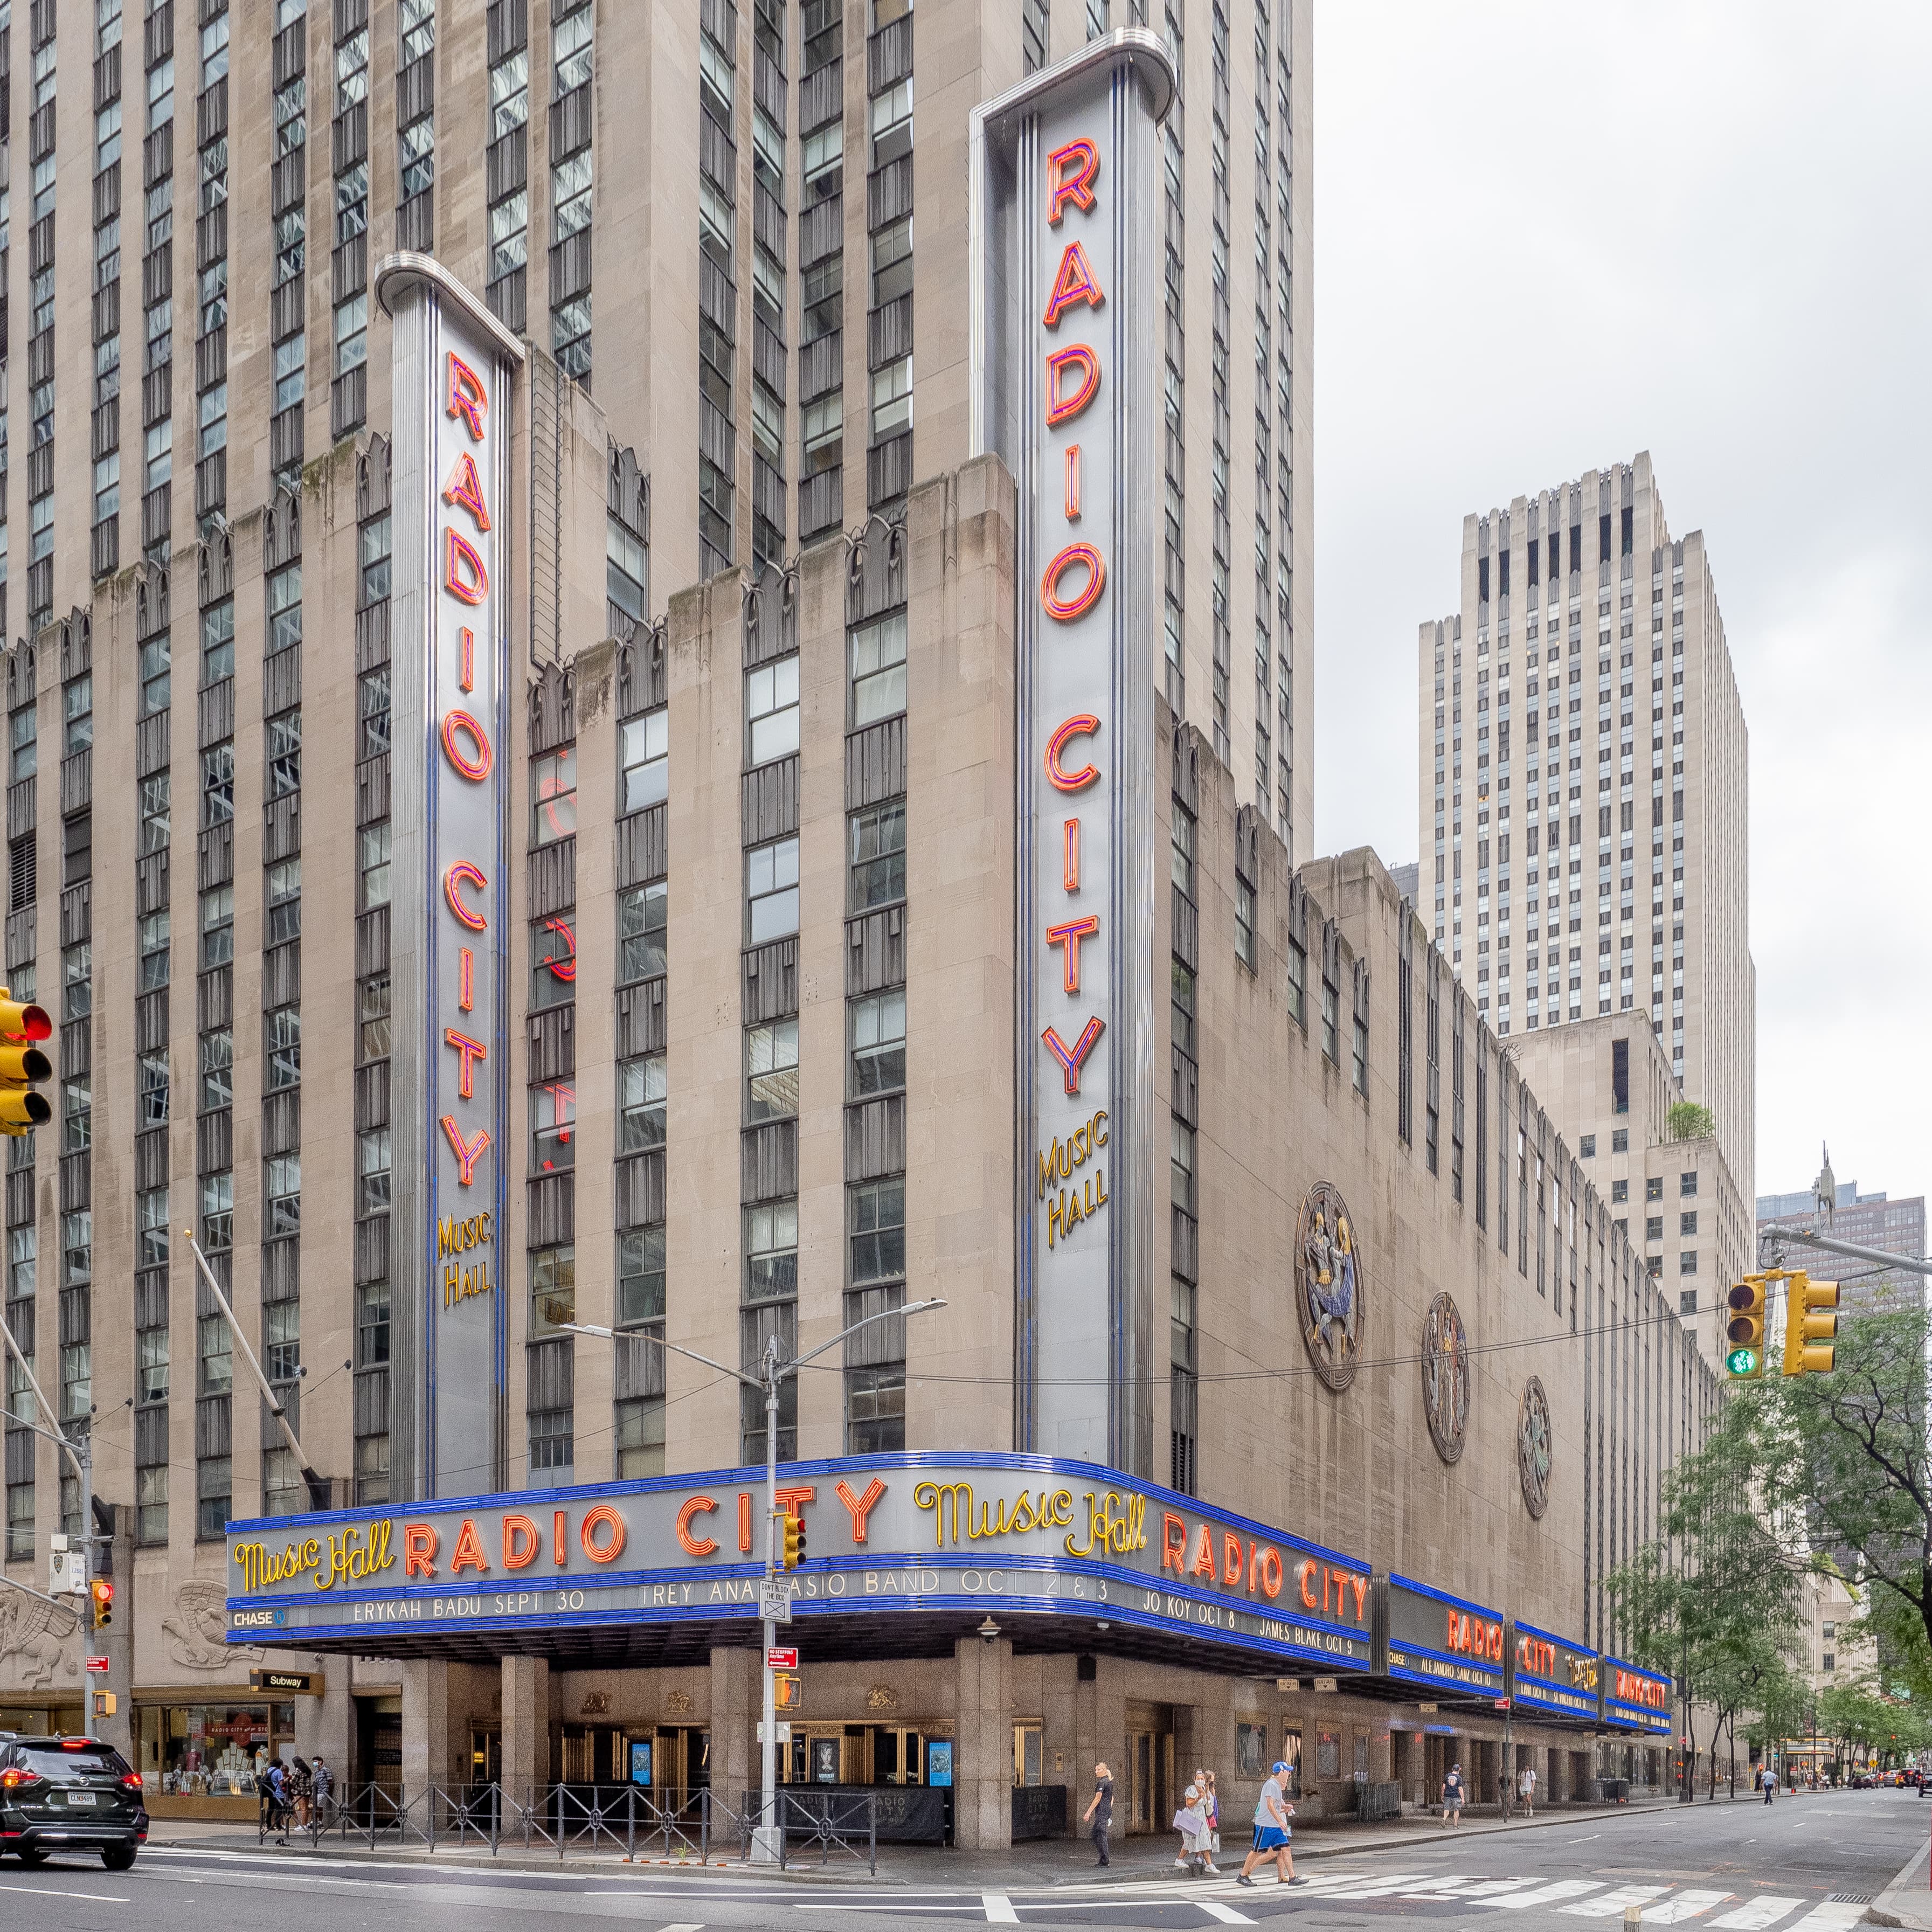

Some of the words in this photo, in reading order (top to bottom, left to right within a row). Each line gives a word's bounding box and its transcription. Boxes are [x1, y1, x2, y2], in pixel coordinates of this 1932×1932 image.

[1041, 137, 1106, 620] RADIO
[441, 351, 492, 781] RADIO
[1042, 715, 1106, 1096] CITY
[440, 860, 490, 1186] CITY
[1040, 1110, 1108, 1200] MUSIC
[1048, 1168, 1108, 1249] HALL
[438, 1212, 490, 1260] MUSIC
[445, 1262, 490, 1308] HALL
[405, 1505, 626, 1578] RADIO
[676, 1477, 887, 1556] CITY
[913, 1481, 1075, 1547] Music
[1065, 1491, 1149, 1557] Hall
[234, 1539, 318, 1592] Music
[314, 1518, 397, 1590] Hall
[1164, 1512, 1283, 1598] RADIO
[1300, 1560, 1367, 1622] CITY
[354, 1599, 421, 1622] ERYKAH
[433, 1596, 481, 1617] BADU
[495, 1592, 541, 1614] SEPT
[557, 1590, 585, 1611] 30
[641, 1582, 694, 1605] TREY
[709, 1574, 846, 1602] ANAASIO
[865, 1569, 939, 1595] BAND
[961, 1569, 1023, 1594] OCT
[1047, 1573, 1058, 1595] 2
[1098, 1580, 1108, 1601] 3
[775, 1585, 789, 1593] BLOCK
[1143, 1592, 1160, 1612] JO
[1167, 1594, 1191, 1620] KOY
[1199, 1604, 1221, 1626] OCT
[1228, 1610, 1235, 1629] 8
[234, 1611, 273, 1626] CHASE
[1259, 1618, 1290, 1642] JAMES
[1296, 1630, 1321, 1651] BLAKE
[1326, 1636, 1343, 1654] OCT
[1347, 1639, 1353, 1656] 9
[1448, 1609, 1502, 1661] RADIO
[1389, 1652, 1405, 1666] CHASE
[1421, 1658, 1455, 1679] ALEJANDRO
[1457, 1666, 1470, 1682] SANZ
[1472, 1670, 1483, 1685] OCT
[1485, 1673, 1491, 1686] 10
[1524, 1636, 1556, 1677] CITY
[270, 1675, 302, 1688] Subway
[1616, 1669, 1643, 1703] RADIO
[1646, 1680, 1665, 1708] CITY
